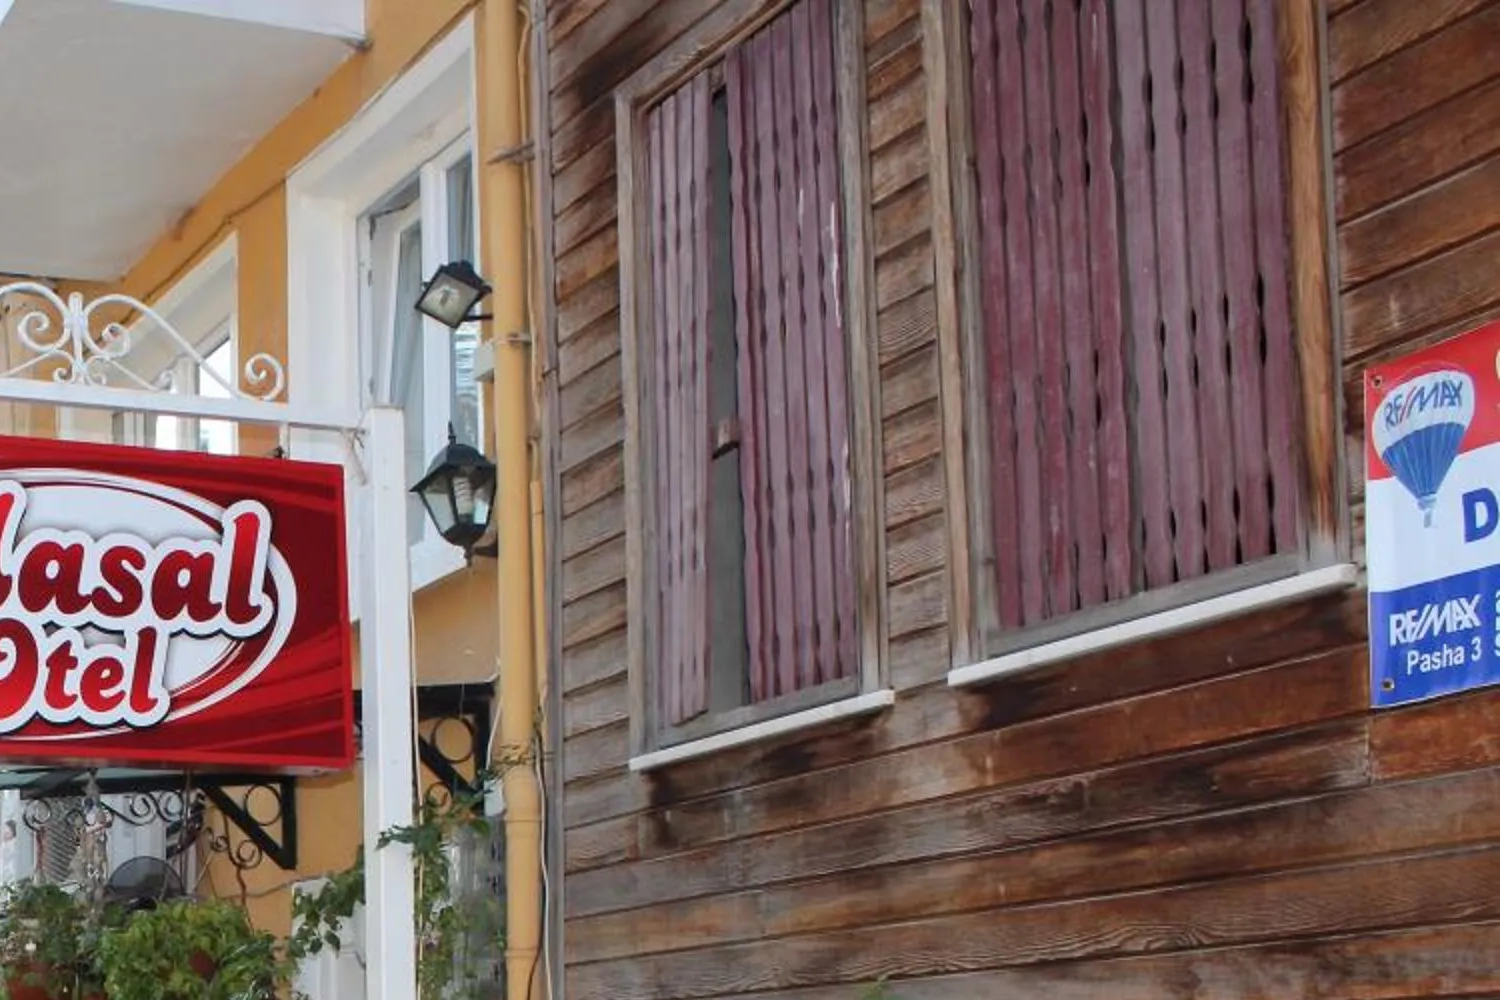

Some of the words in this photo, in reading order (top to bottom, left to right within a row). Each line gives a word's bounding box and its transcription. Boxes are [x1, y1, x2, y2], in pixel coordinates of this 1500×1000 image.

[1385, 379, 1463, 431] RE/MAX
[1389, 593, 1481, 647] RE/MAX
[1407, 643, 1465, 676] Pasha
[1471, 636, 1481, 662] 3
